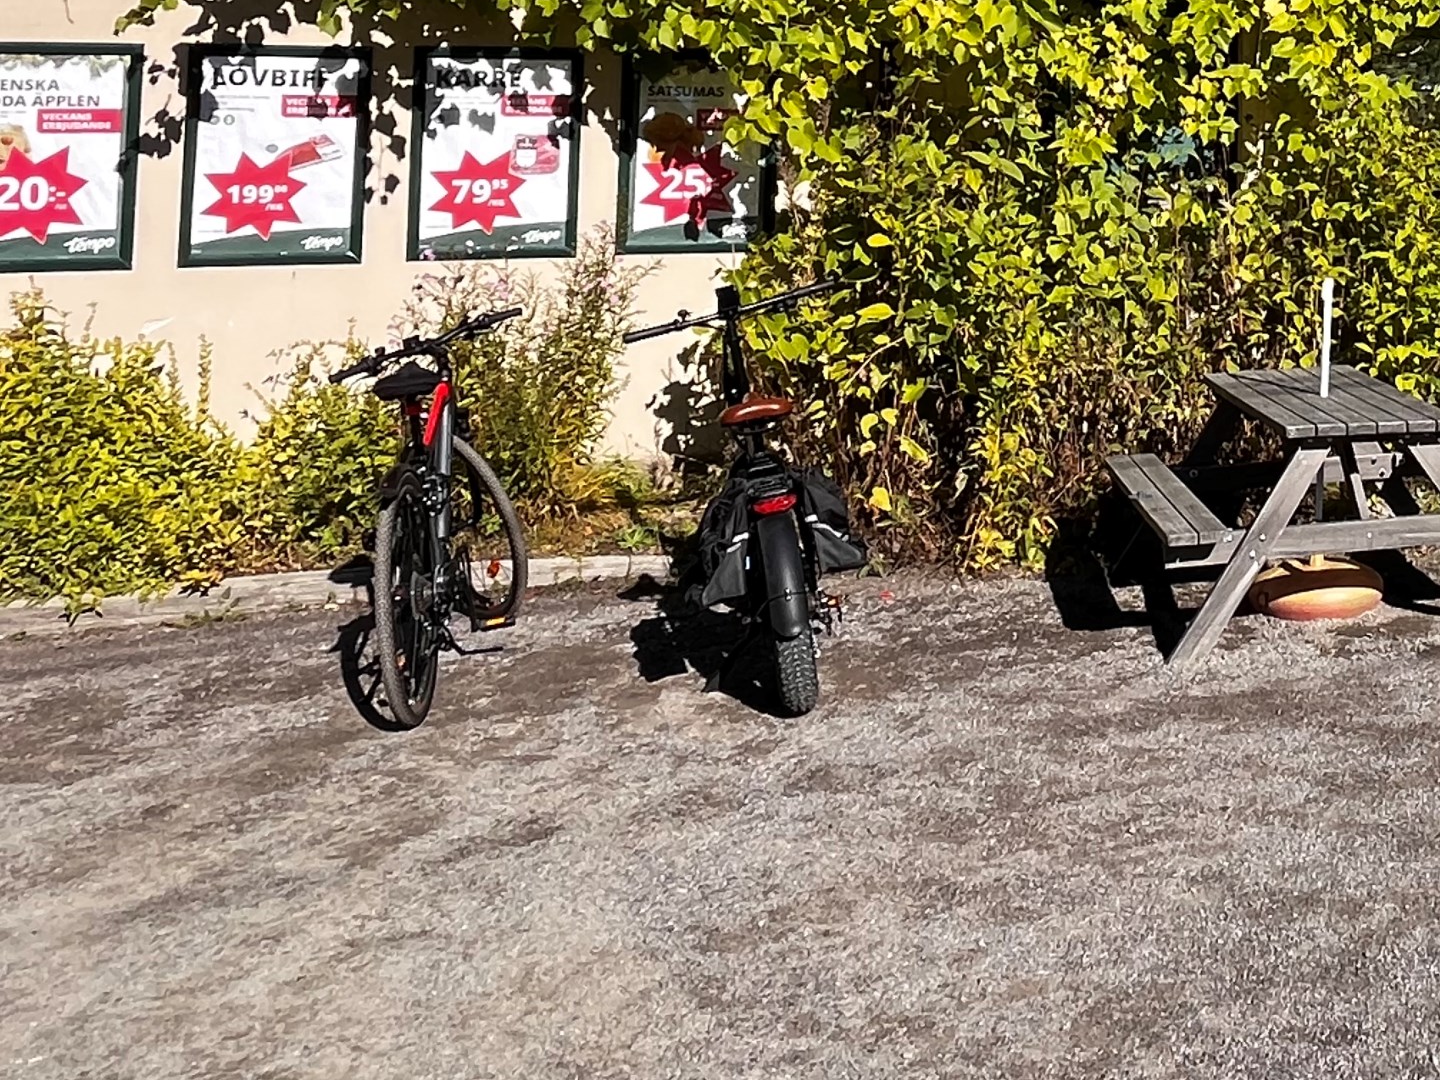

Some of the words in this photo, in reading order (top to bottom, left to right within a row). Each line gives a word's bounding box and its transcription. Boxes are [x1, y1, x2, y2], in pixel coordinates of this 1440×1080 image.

[648, 86, 724, 97] SATSUMAS
[0, 96, 26, 107] DA
[31, 93, 99, 107] ÄPPLEN
[63, 237, 116, 254] tempo
